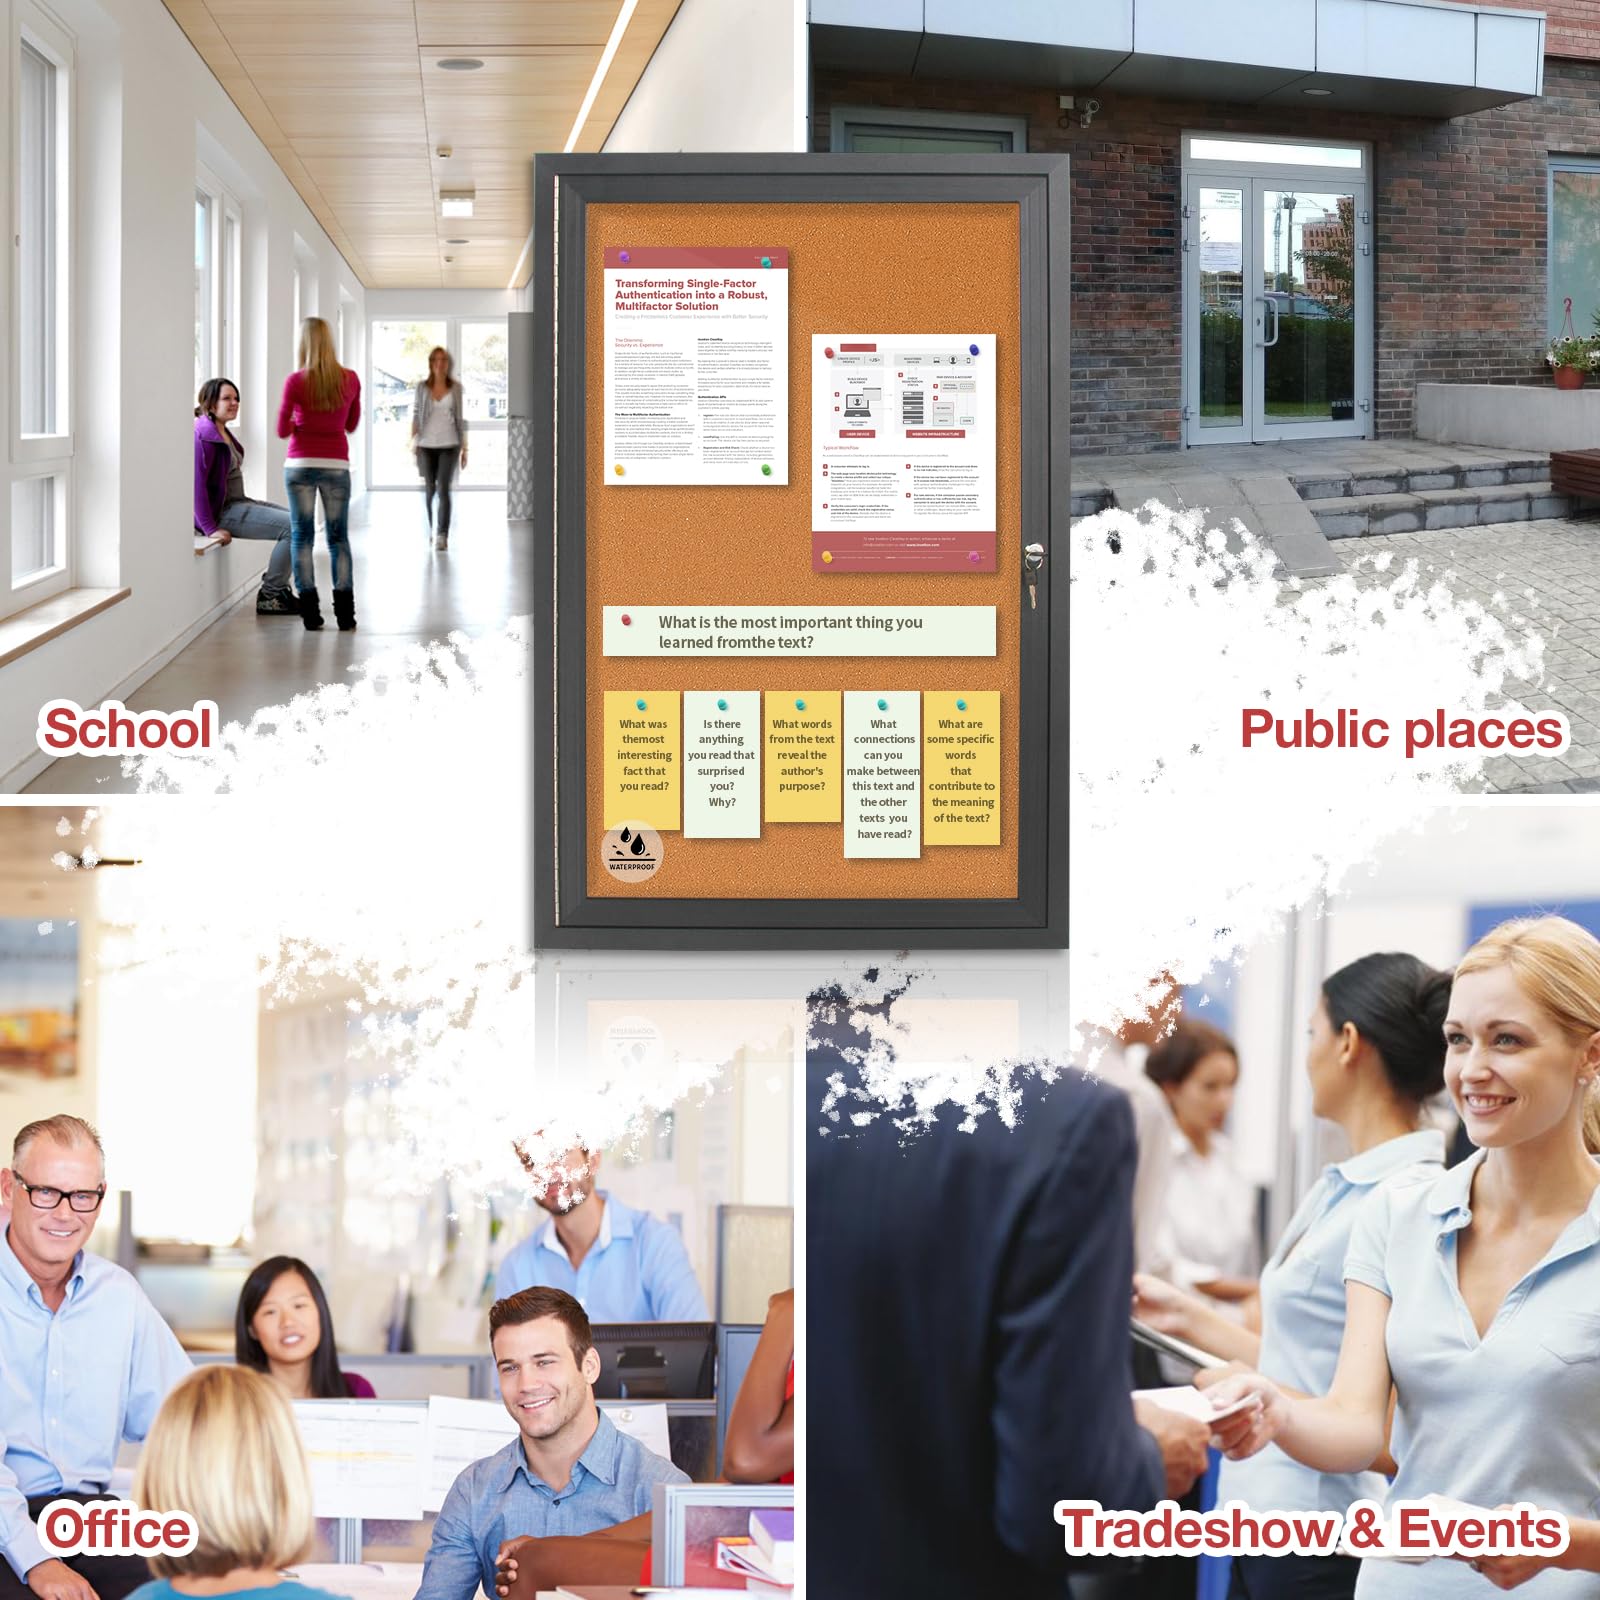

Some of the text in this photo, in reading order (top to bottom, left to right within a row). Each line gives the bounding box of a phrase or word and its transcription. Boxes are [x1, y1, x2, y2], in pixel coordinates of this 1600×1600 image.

[615, 279, 756, 290] Transforming Single-Factor
[615, 290, 692, 299] Authentication
[696, 290, 715, 299] into
[728, 291, 767, 300] Robust,
[616, 302, 718, 310] Multifactor Solution
[659, 616, 922, 632] What is the most important thing you
[660, 636, 713, 648] learned
[778, 636, 813, 648] text?
[620, 720, 645, 728] What
[704, 720, 741, 728] Is there
[773, 720, 832, 728] What words
[871, 720, 897, 728] What
[939, 720, 965, 728] What
[699, 734, 744, 746] anything
[769, 734, 794, 743] from
[796, 734, 813, 743] the
[854, 734, 915, 743] connections
[957, 734, 994, 745] specific
[618, 750, 672, 762] interesting
[688, 750, 755, 761] you read that
[778, 750, 827, 759] reveal the
[884, 753, 902, 761] you
[945, 750, 976, 759] words
[624, 766, 666, 775] fact that
[698, 766, 744, 777] surprised
[781, 766, 823, 775] author's
[847, 766, 920, 775] make between
[950, 766, 972, 775] that
[620, 781, 669, 792] you read?
[710, 782, 734, 792] you?
[780, 782, 825, 792] purpose?
[852, 781, 914, 790] this text and
[929, 781, 995, 790] contribute to
[709, 797, 736, 808] Why?
[860, 797, 907, 806] the other
[932, 797, 994, 809] the meaning
[859, 814, 907, 824] texts you
[934, 813, 990, 822] of the text?
[858, 829, 912, 838] have read?
